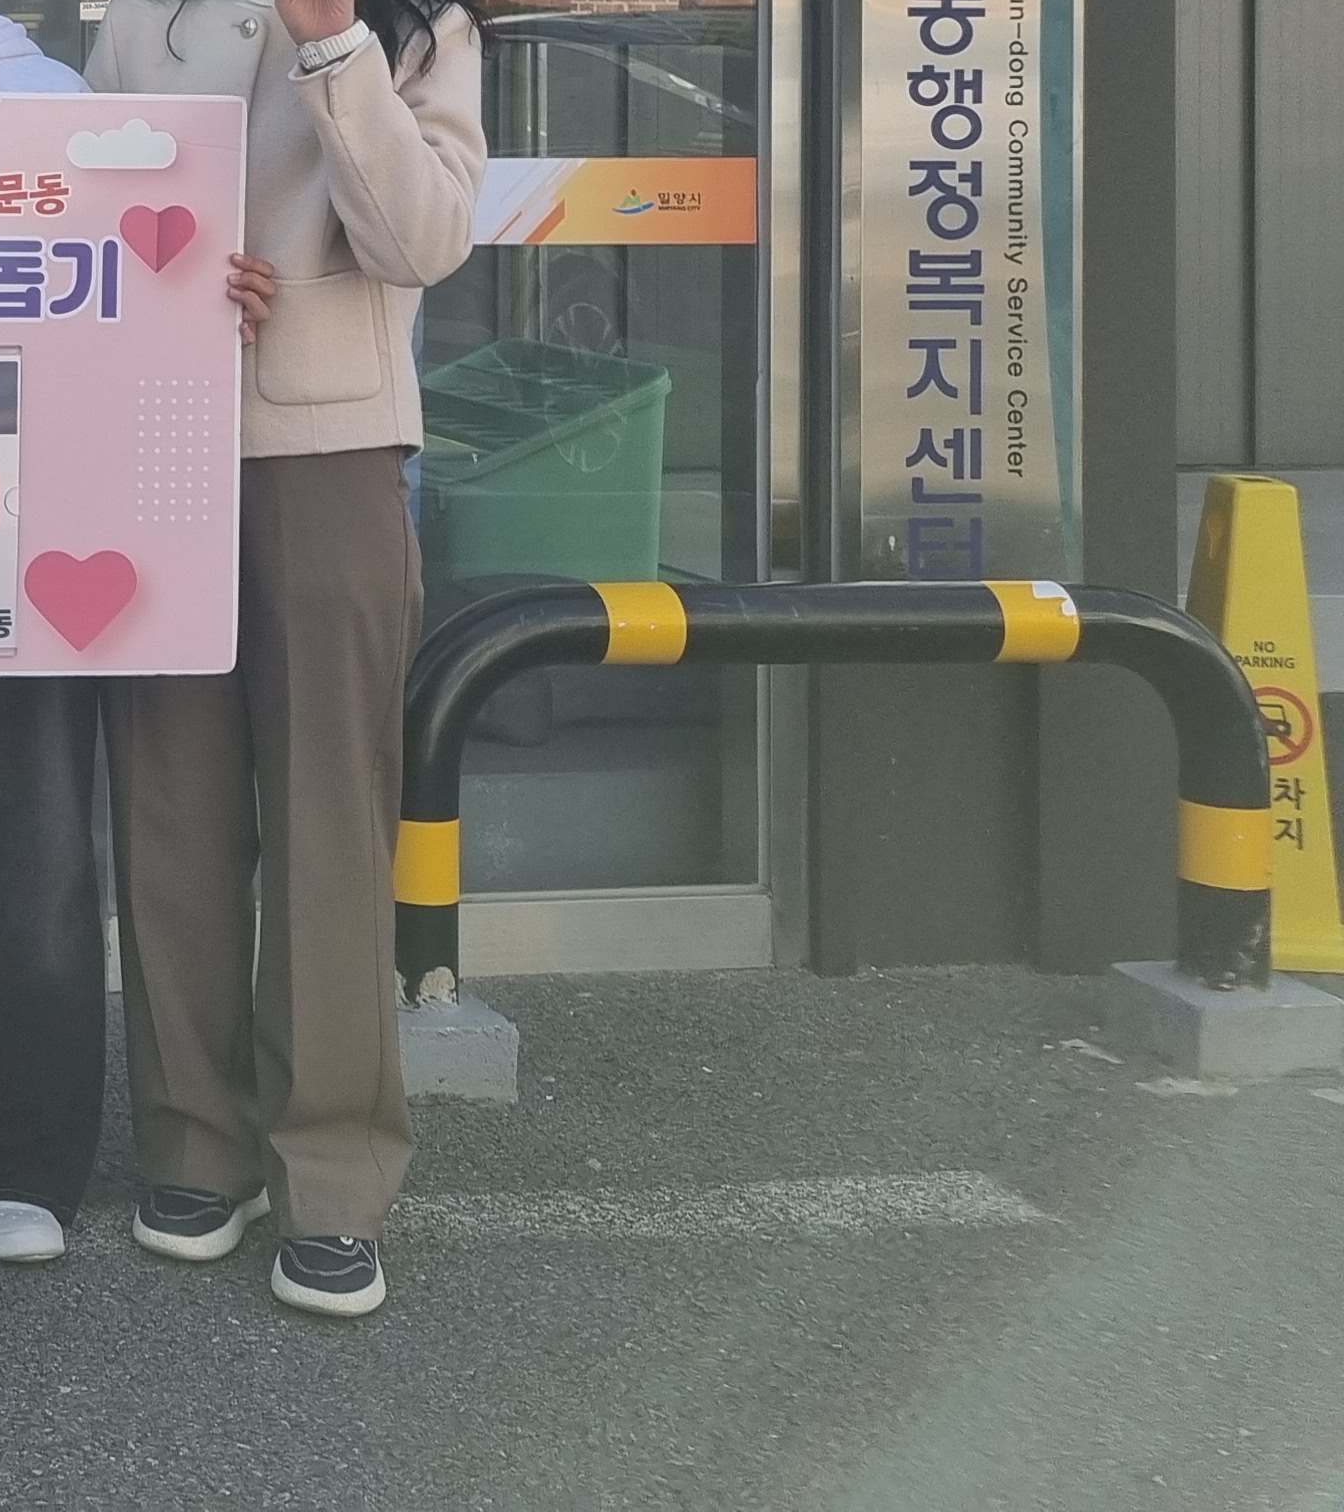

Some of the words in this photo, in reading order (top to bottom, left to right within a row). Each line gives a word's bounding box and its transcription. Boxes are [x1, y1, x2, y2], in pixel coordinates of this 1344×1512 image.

[657, 192, 701, 205] 밀양시
[1004, 119, 1029, 266] Community
[1007, 277, 1029, 378] Service
[1006, 389, 1028, 478] Center
[1235, 655, 1295, 669] PARKING
[1253, 641, 1275, 653] NO
[1273, 778, 1305, 810] 차
[1273, 818, 1304, 851] 지
